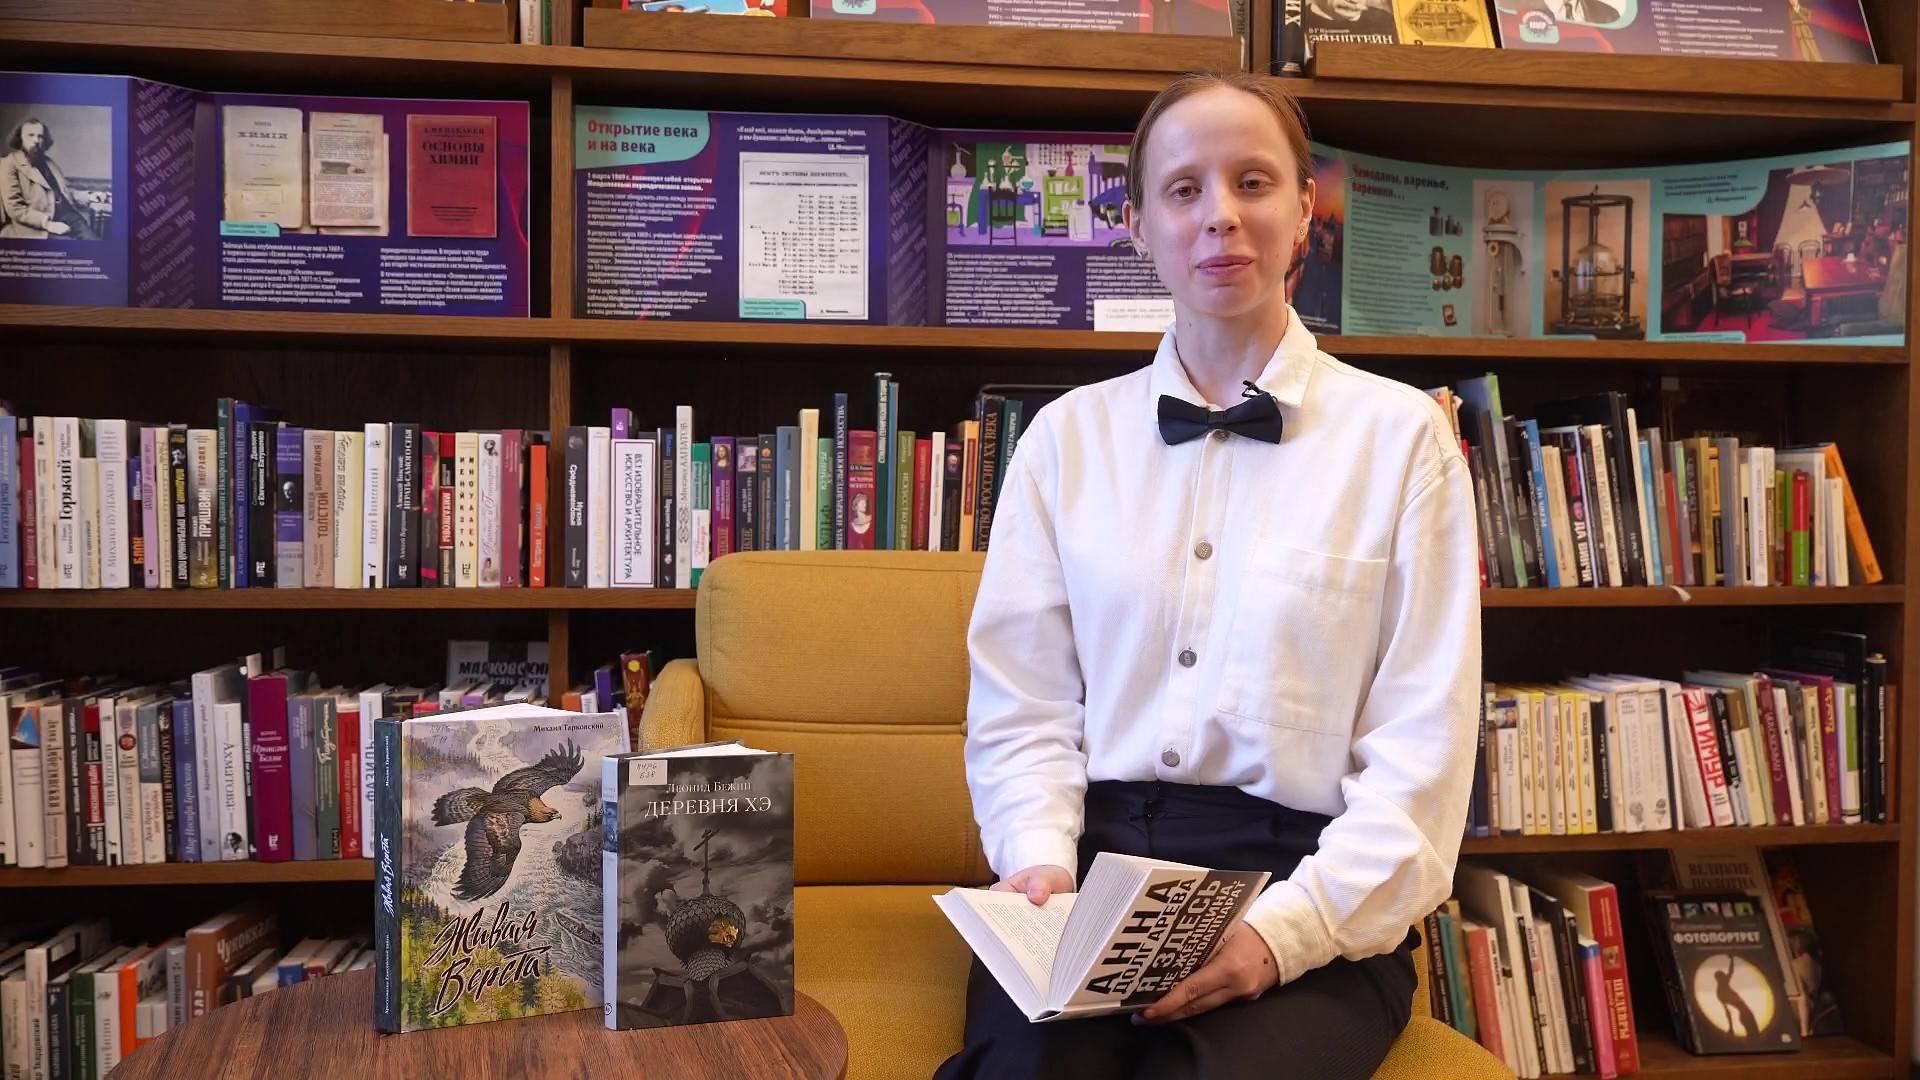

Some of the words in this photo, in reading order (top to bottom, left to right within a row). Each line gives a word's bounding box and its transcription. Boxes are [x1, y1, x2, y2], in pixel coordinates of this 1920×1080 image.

[422, 141, 486, 153] ОСНОВЫ
[587, 120, 660, 137] Открытие
[663, 126, 698, 138] века
[587, 141, 596, 151] и
[600, 142, 618, 152] на
[621, 142, 656, 153] века
[427, 154, 480, 166] ХИМИИ
[1403, 174, 1450, 192] варенье,
[984, 411, 998, 438] ВЕКА
[624, 453, 633, 506] ИСКУССТВО
[634, 453, 642, 468] 85.1
[58, 459, 76, 520] Горький
[980, 460, 994, 506] РОССИИ
[198, 488, 212, 538] ПРИШВИН
[316, 491, 329, 539] ТОЛСТОЙ
[442, 492, 452, 543] МИХАЛКОВЫ
[634, 469, 642, 556] ИЗОБРАЗИТЕЛЬНОЕ
[1574, 521, 1586, 540] ДА
[624, 517, 633, 579] АРХИТЕКТУРА
[1577, 541, 1592, 582] ВИНЧИ
[533, 724, 562, 733] Михаил
[563, 722, 604, 733] Тарковский
[644, 798, 739, 819] ДЕРЕВНЯ
[744, 797, 772, 812] ХЭ
[666, 784, 711, 794] Леонид
[714, 781, 751, 792] Бежин
[380, 832, 395, 875] Верста
[1688, 863, 1750, 876] ВЕЛИКИЕ
[382, 875, 396, 918] Живая
[424, 901, 539, 967] Живая
[1085, 879, 1181, 995] АННА
[1112, 879, 1197, 995] ДОЛГАРЕВА
[1136, 976, 1161, 992] Я
[1152, 880, 1222, 969] ЗДЕСЬ
[1673, 931, 1760, 944] ФОТОПОРТРЕТ
[432, 945, 552, 1016] Верста
[1157, 971, 1179, 992] НЕ
[1612, 978, 1630, 1040] ШЕДЕВРЫ
